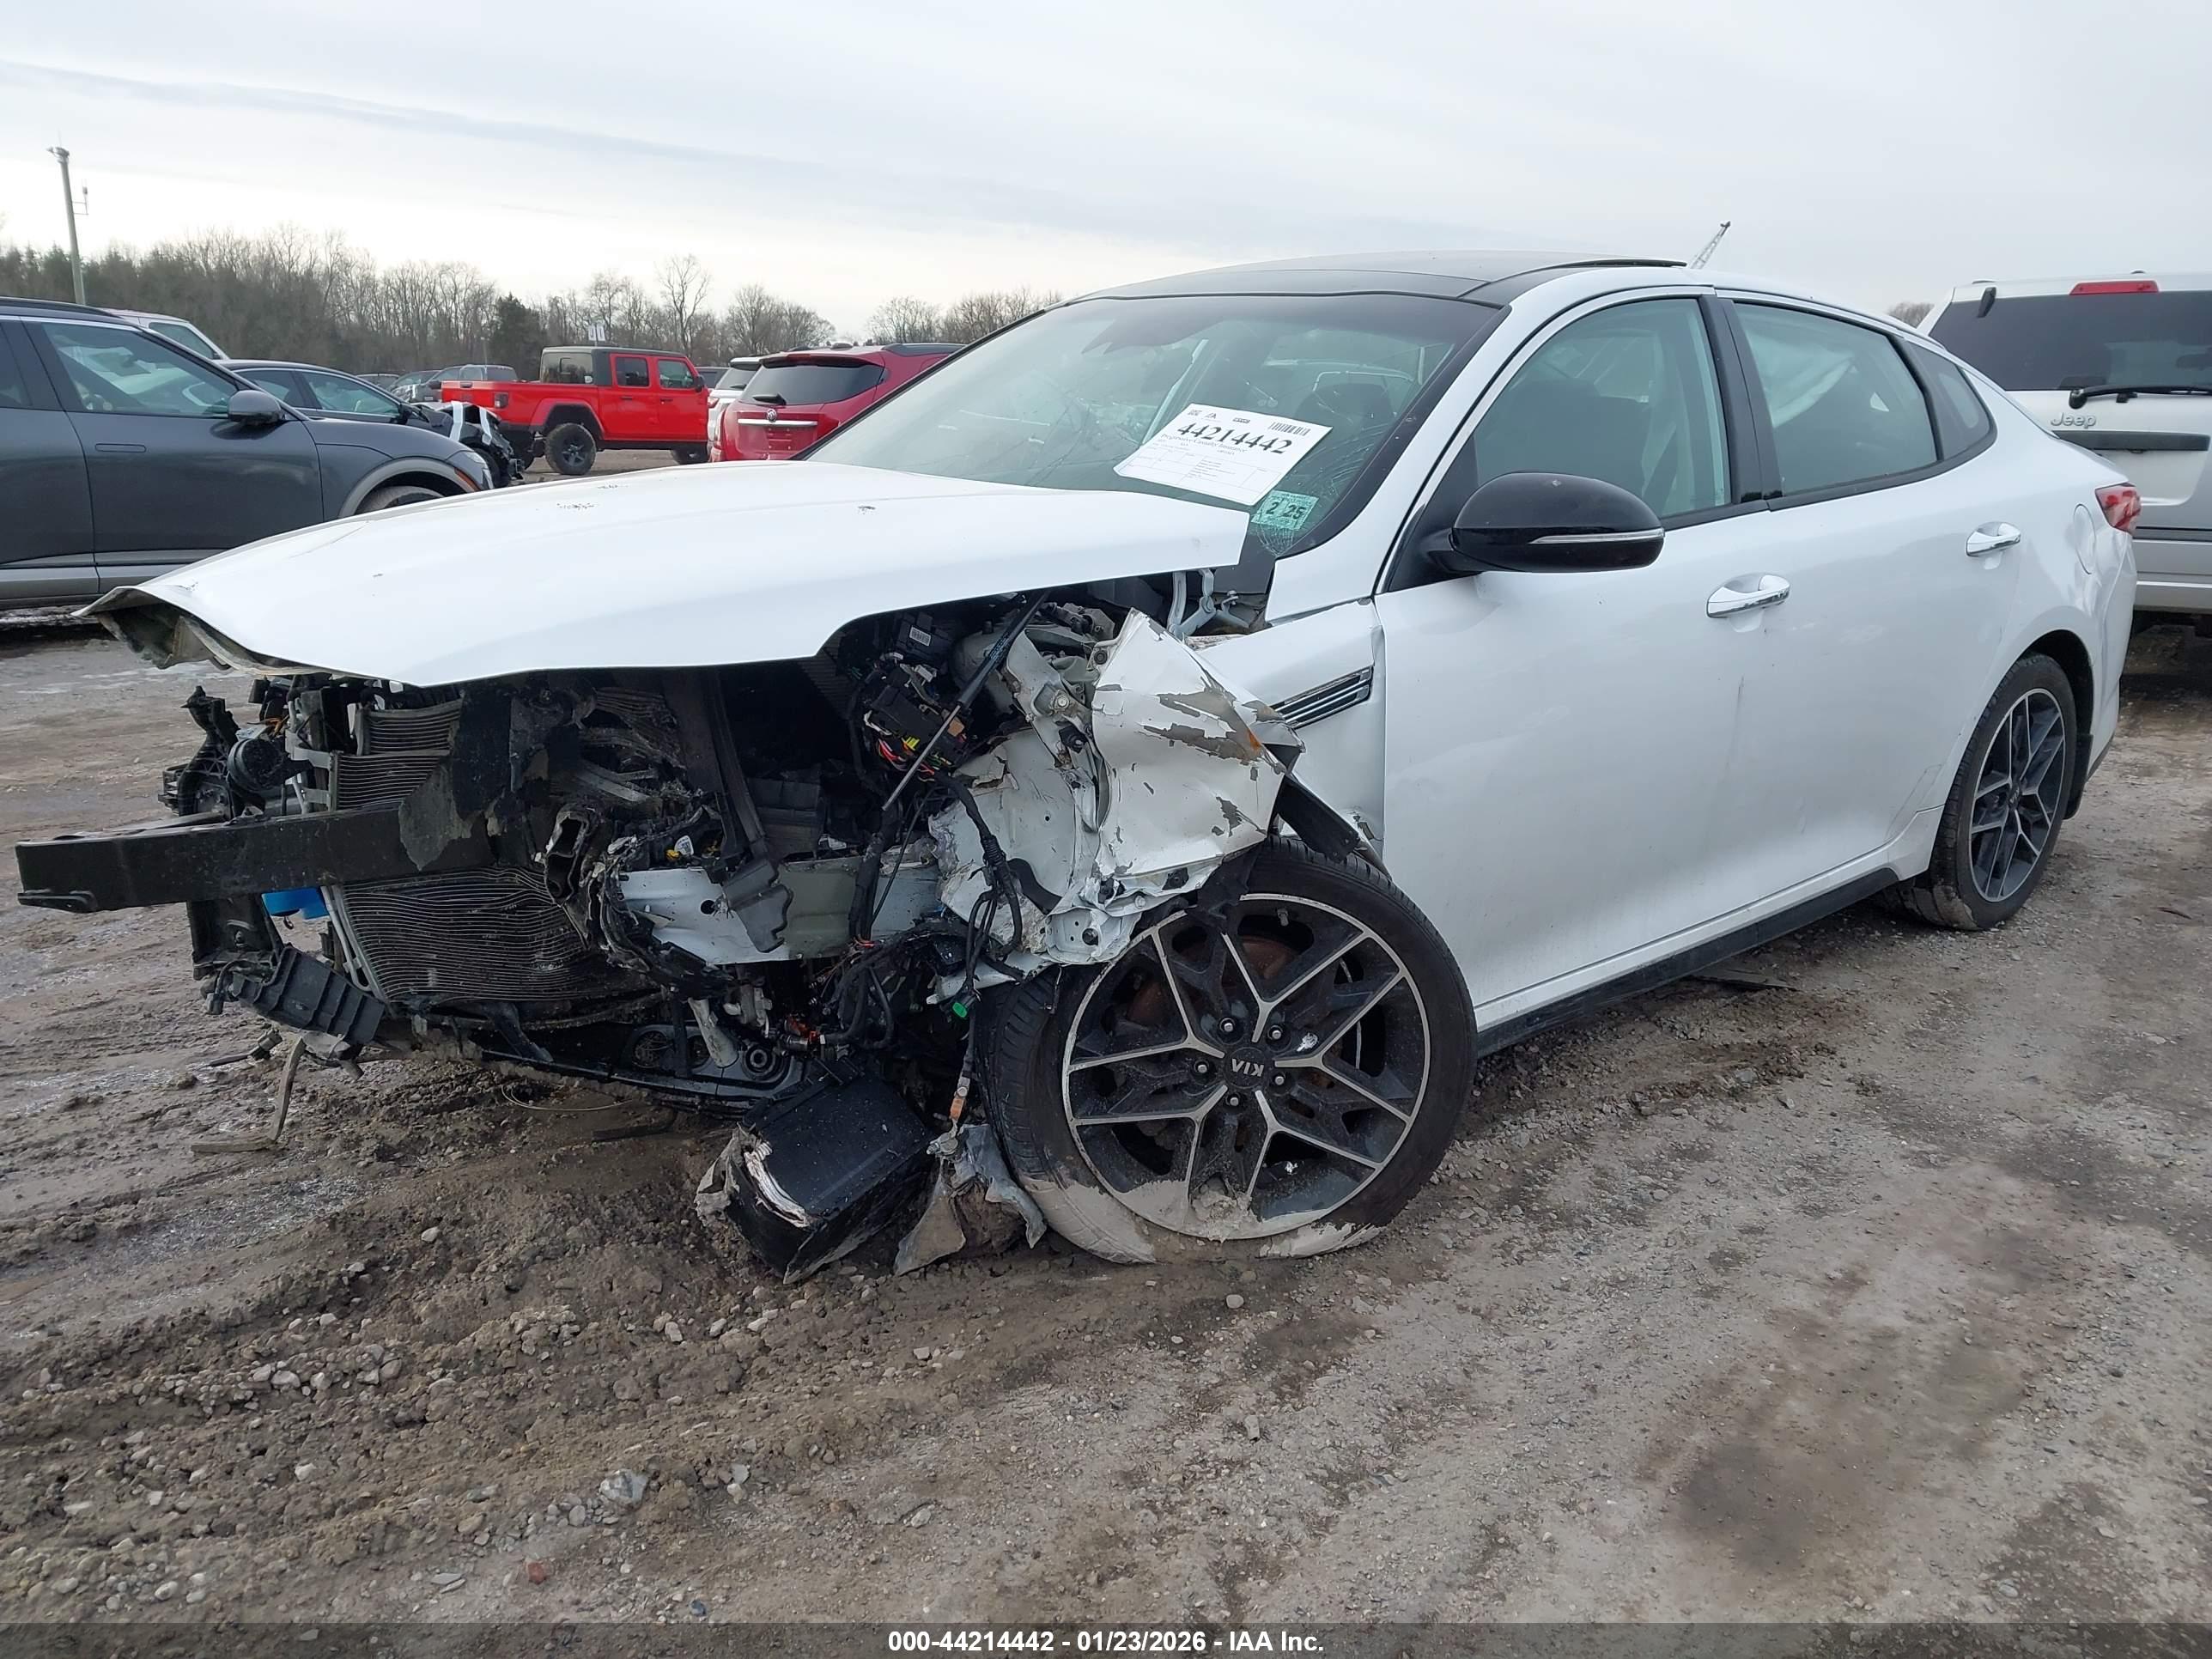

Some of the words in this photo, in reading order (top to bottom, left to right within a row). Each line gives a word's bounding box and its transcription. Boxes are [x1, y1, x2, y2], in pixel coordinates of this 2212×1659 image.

[2051, 413, 2097, 428] Jeep
[1177, 422, 1292, 454] 44214442
[1282, 504, 1307, 520] 25
[1231, 1058, 1265, 1077] KIA
